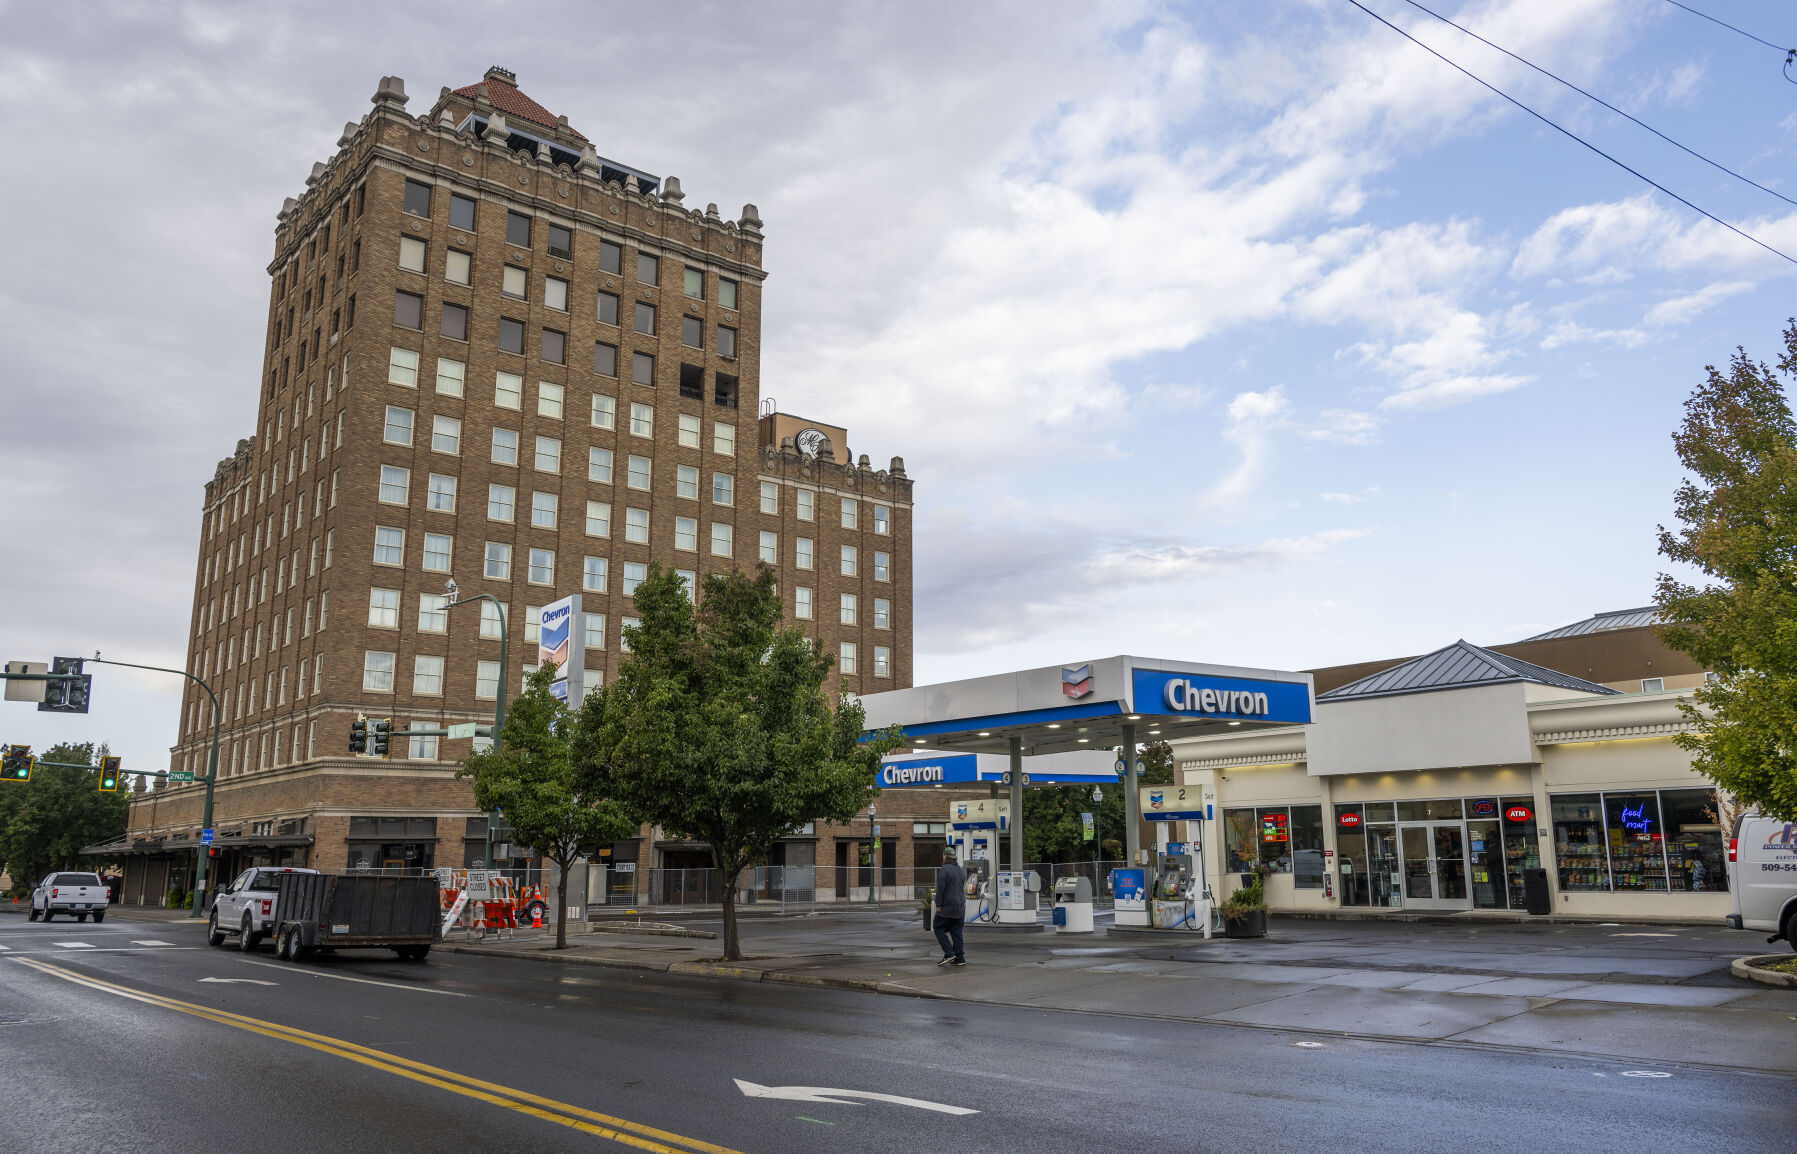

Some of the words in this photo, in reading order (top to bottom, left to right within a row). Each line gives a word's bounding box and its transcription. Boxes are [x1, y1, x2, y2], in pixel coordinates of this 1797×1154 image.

[542, 605, 570, 624] Chevron
[1164, 679, 1268, 715] Chevron
[884, 765, 943, 784] Chevron
[1178, 789, 1186, 800] 2
[978, 803, 984, 812] 4
[1510, 810, 1526, 818] ATM
[1621, 803, 1645, 823] food
[1626, 818, 1653, 833] mart
[470, 873, 485, 882] STREET
[470, 883, 487, 892] CLOSED
